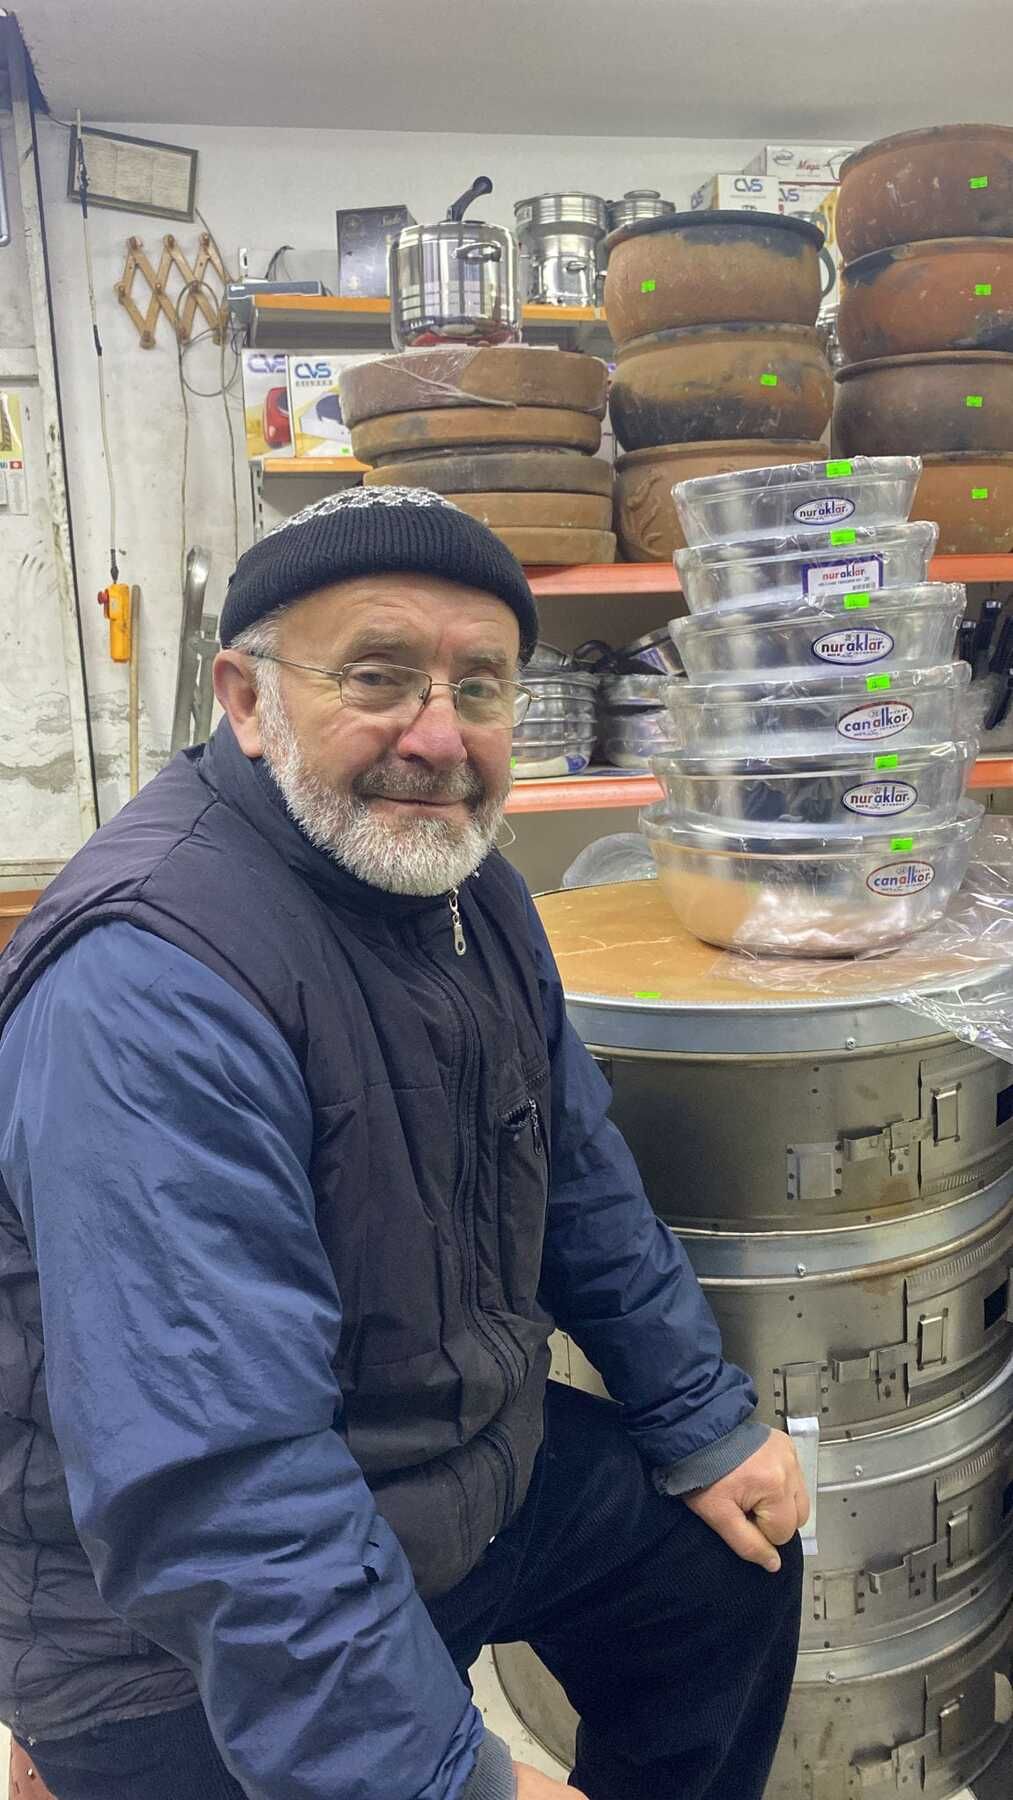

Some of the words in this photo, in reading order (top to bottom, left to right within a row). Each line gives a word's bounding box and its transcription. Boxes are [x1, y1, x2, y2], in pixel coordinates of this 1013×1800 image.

[734, 178, 763, 193] CVS
[295, 362, 332, 379] CVS
[844, 706, 908, 732] canalkor
[873, 865, 930, 887] canalkor
